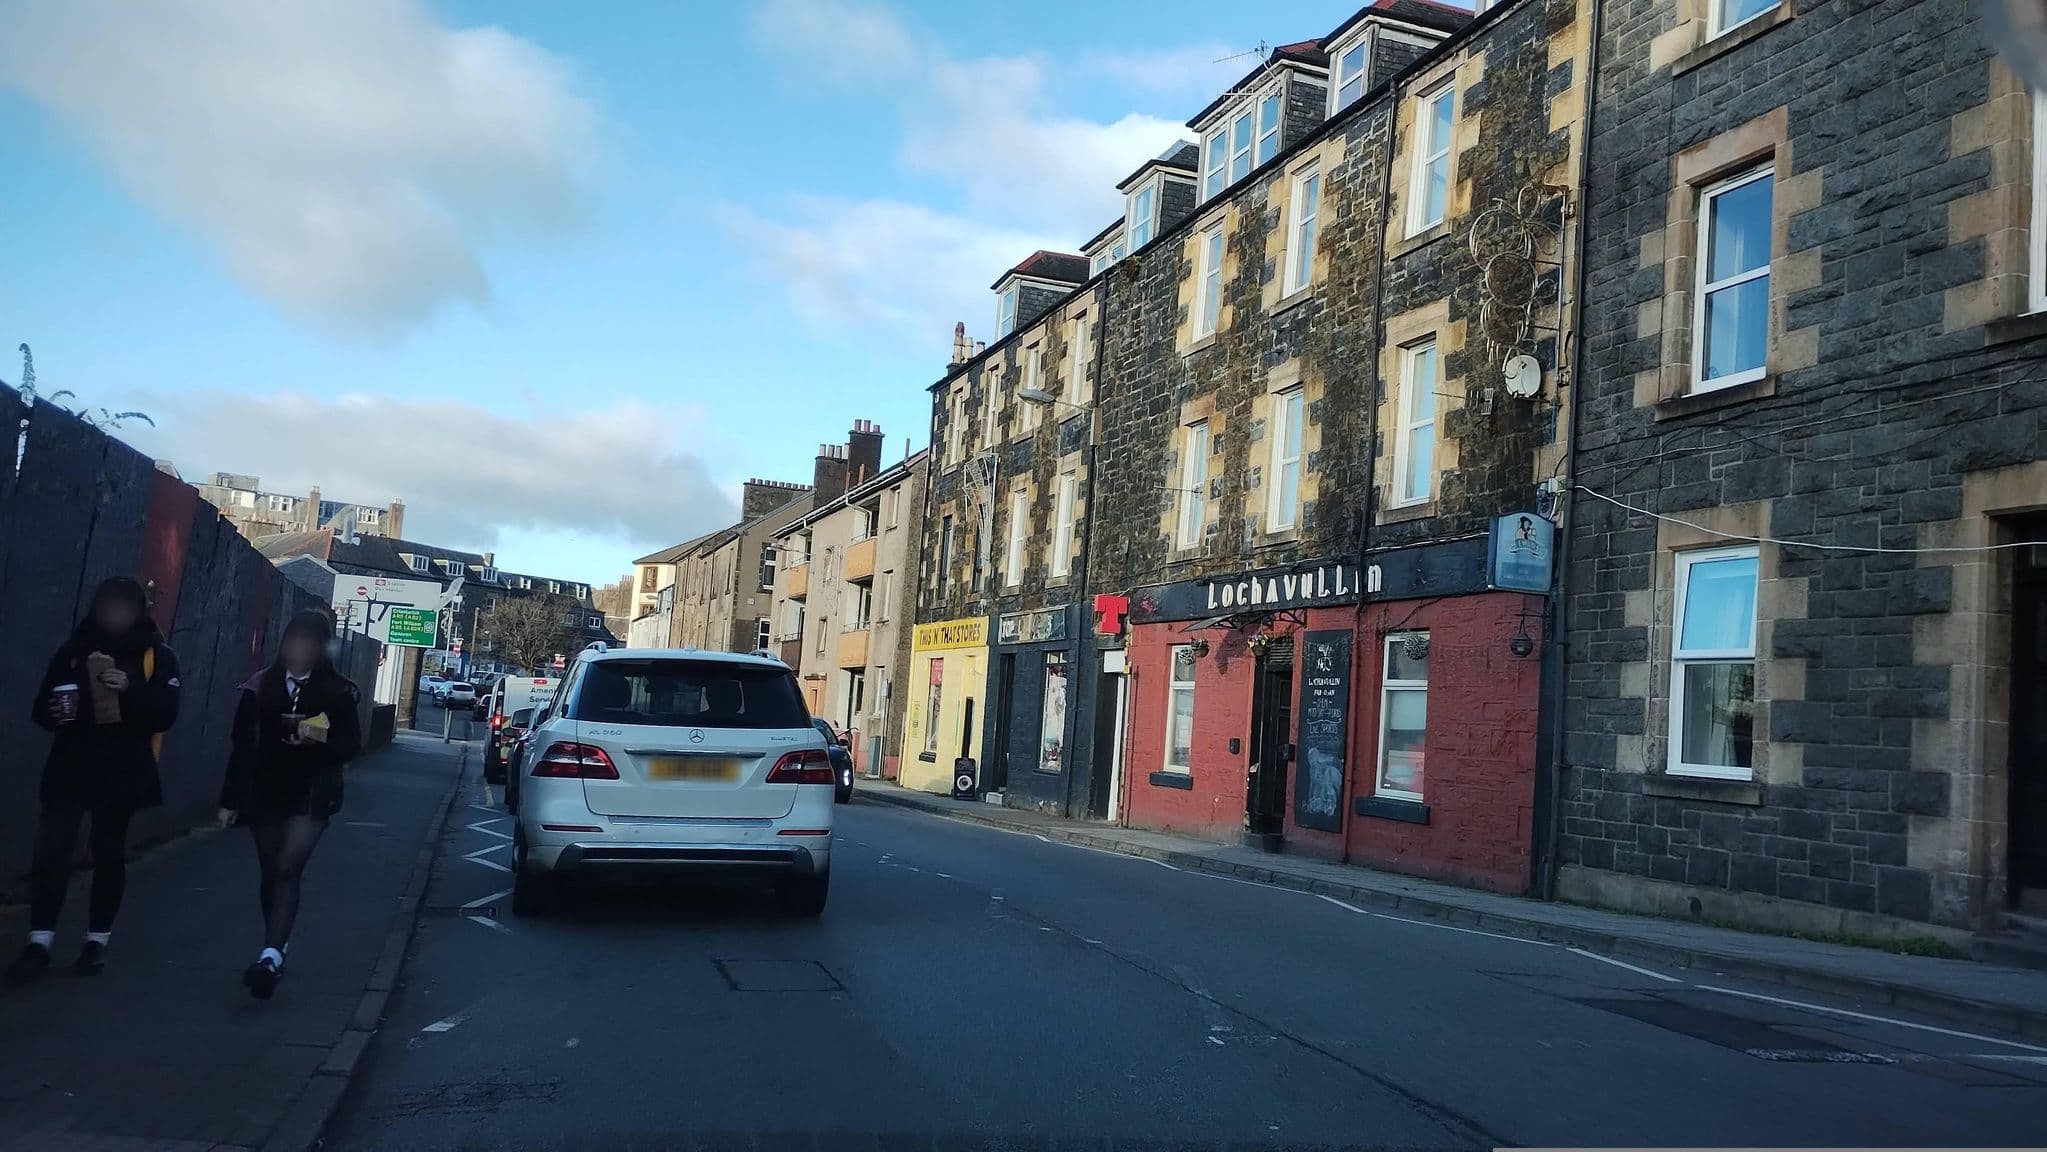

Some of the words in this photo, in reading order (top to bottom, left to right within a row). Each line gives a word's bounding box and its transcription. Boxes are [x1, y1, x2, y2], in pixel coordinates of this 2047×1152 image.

[919, 628, 931, 646] THIS
[940, 626, 957, 644] THAT
[956, 623, 981, 643] STORES
